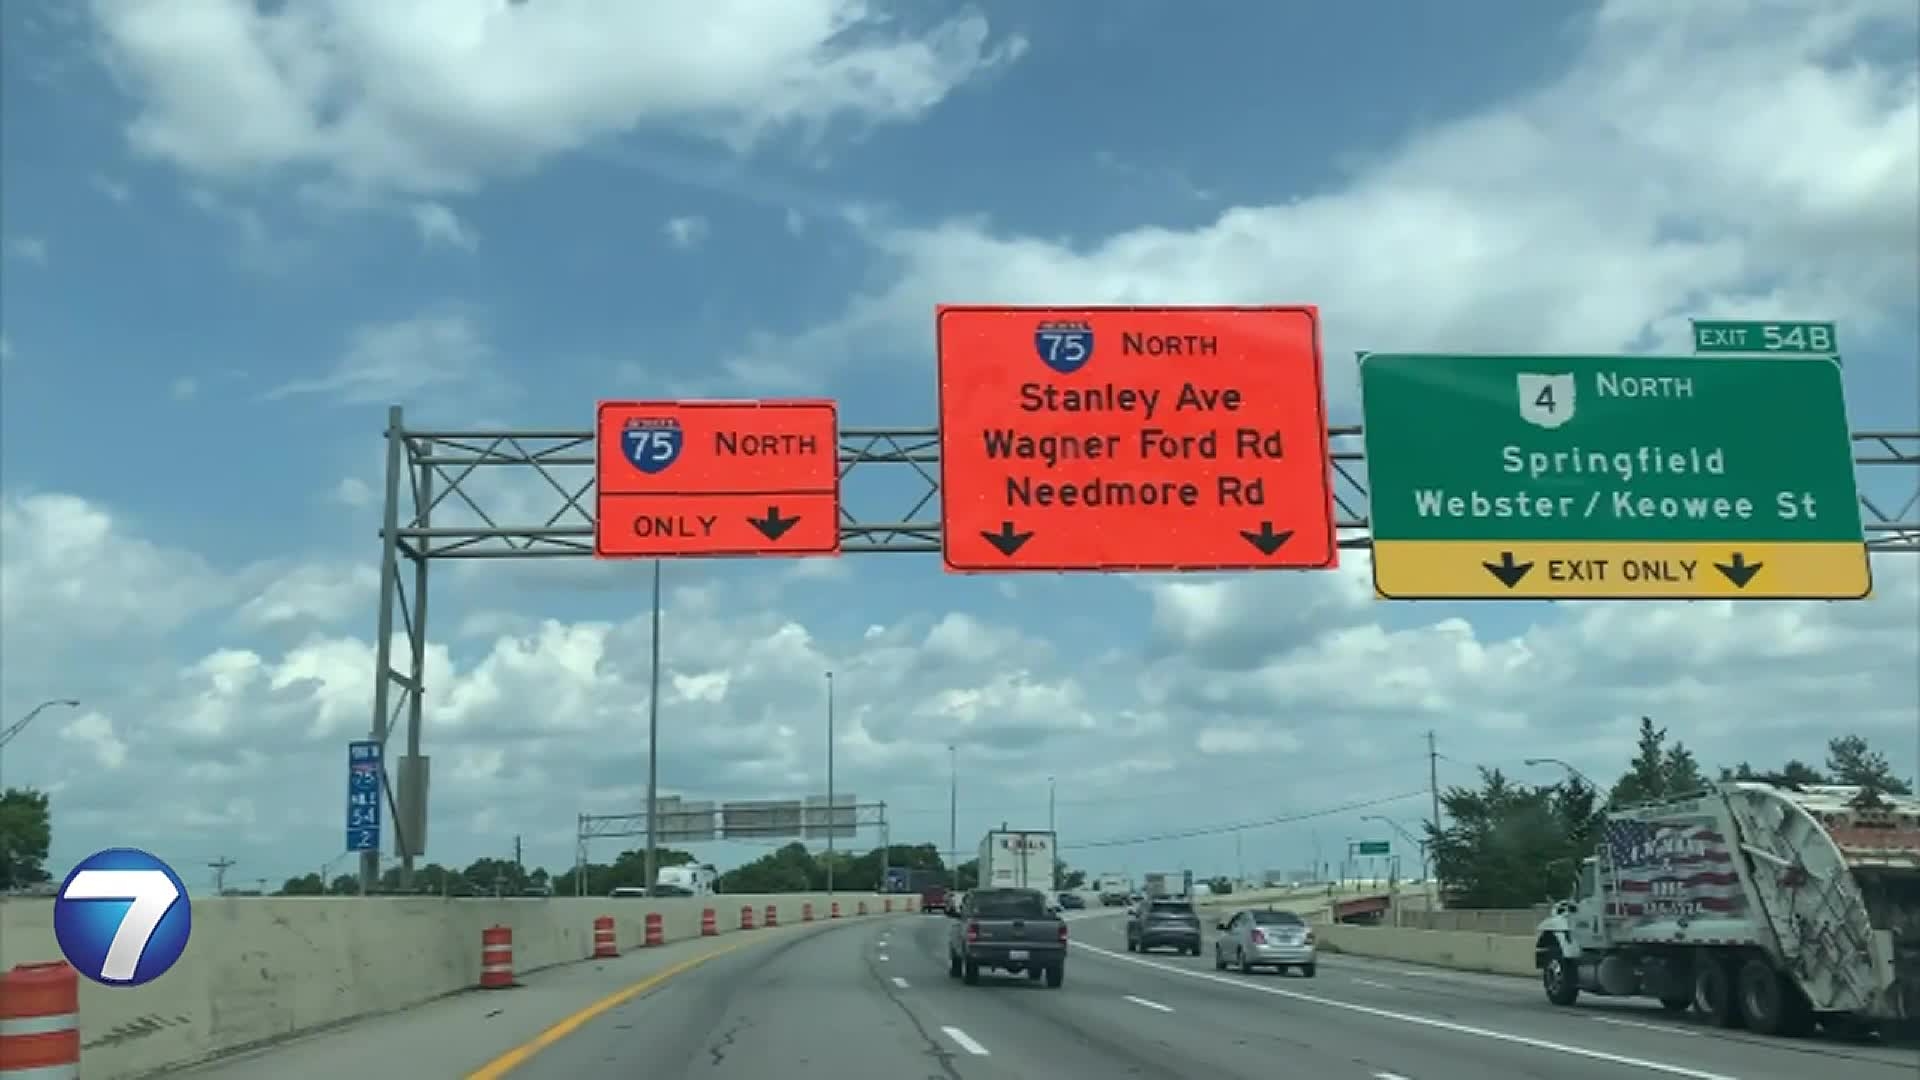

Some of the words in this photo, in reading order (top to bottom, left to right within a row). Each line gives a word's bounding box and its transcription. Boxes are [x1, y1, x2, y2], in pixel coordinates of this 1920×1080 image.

[1042, 333, 1085, 361] 75
[1122, 332, 1217, 356] NORTH
[1700, 330, 1746, 346] EXIT
[1763, 326, 1830, 350] 54B
[1020, 382, 1160, 420] Stanley
[1176, 382, 1241, 411] Ave
[1536, 384, 1556, 413] 4
[1597, 372, 1693, 398] NORTH
[628, 431, 673, 461] 75
[715, 431, 817, 456] NORTH
[983, 428, 1121, 469] Wagner
[1140, 428, 1217, 459] Ford
[1236, 428, 1283, 459] Rd
[1502, 446, 1725, 481] Springfield
[1006, 476, 1199, 507] Needmore
[1217, 476, 1265, 506] Rd
[1776, 491, 1817, 519] St
[633, 515, 717, 537] ONLY
[1548, 561, 1609, 581] EXIT
[1623, 560, 1698, 581] ONLY
